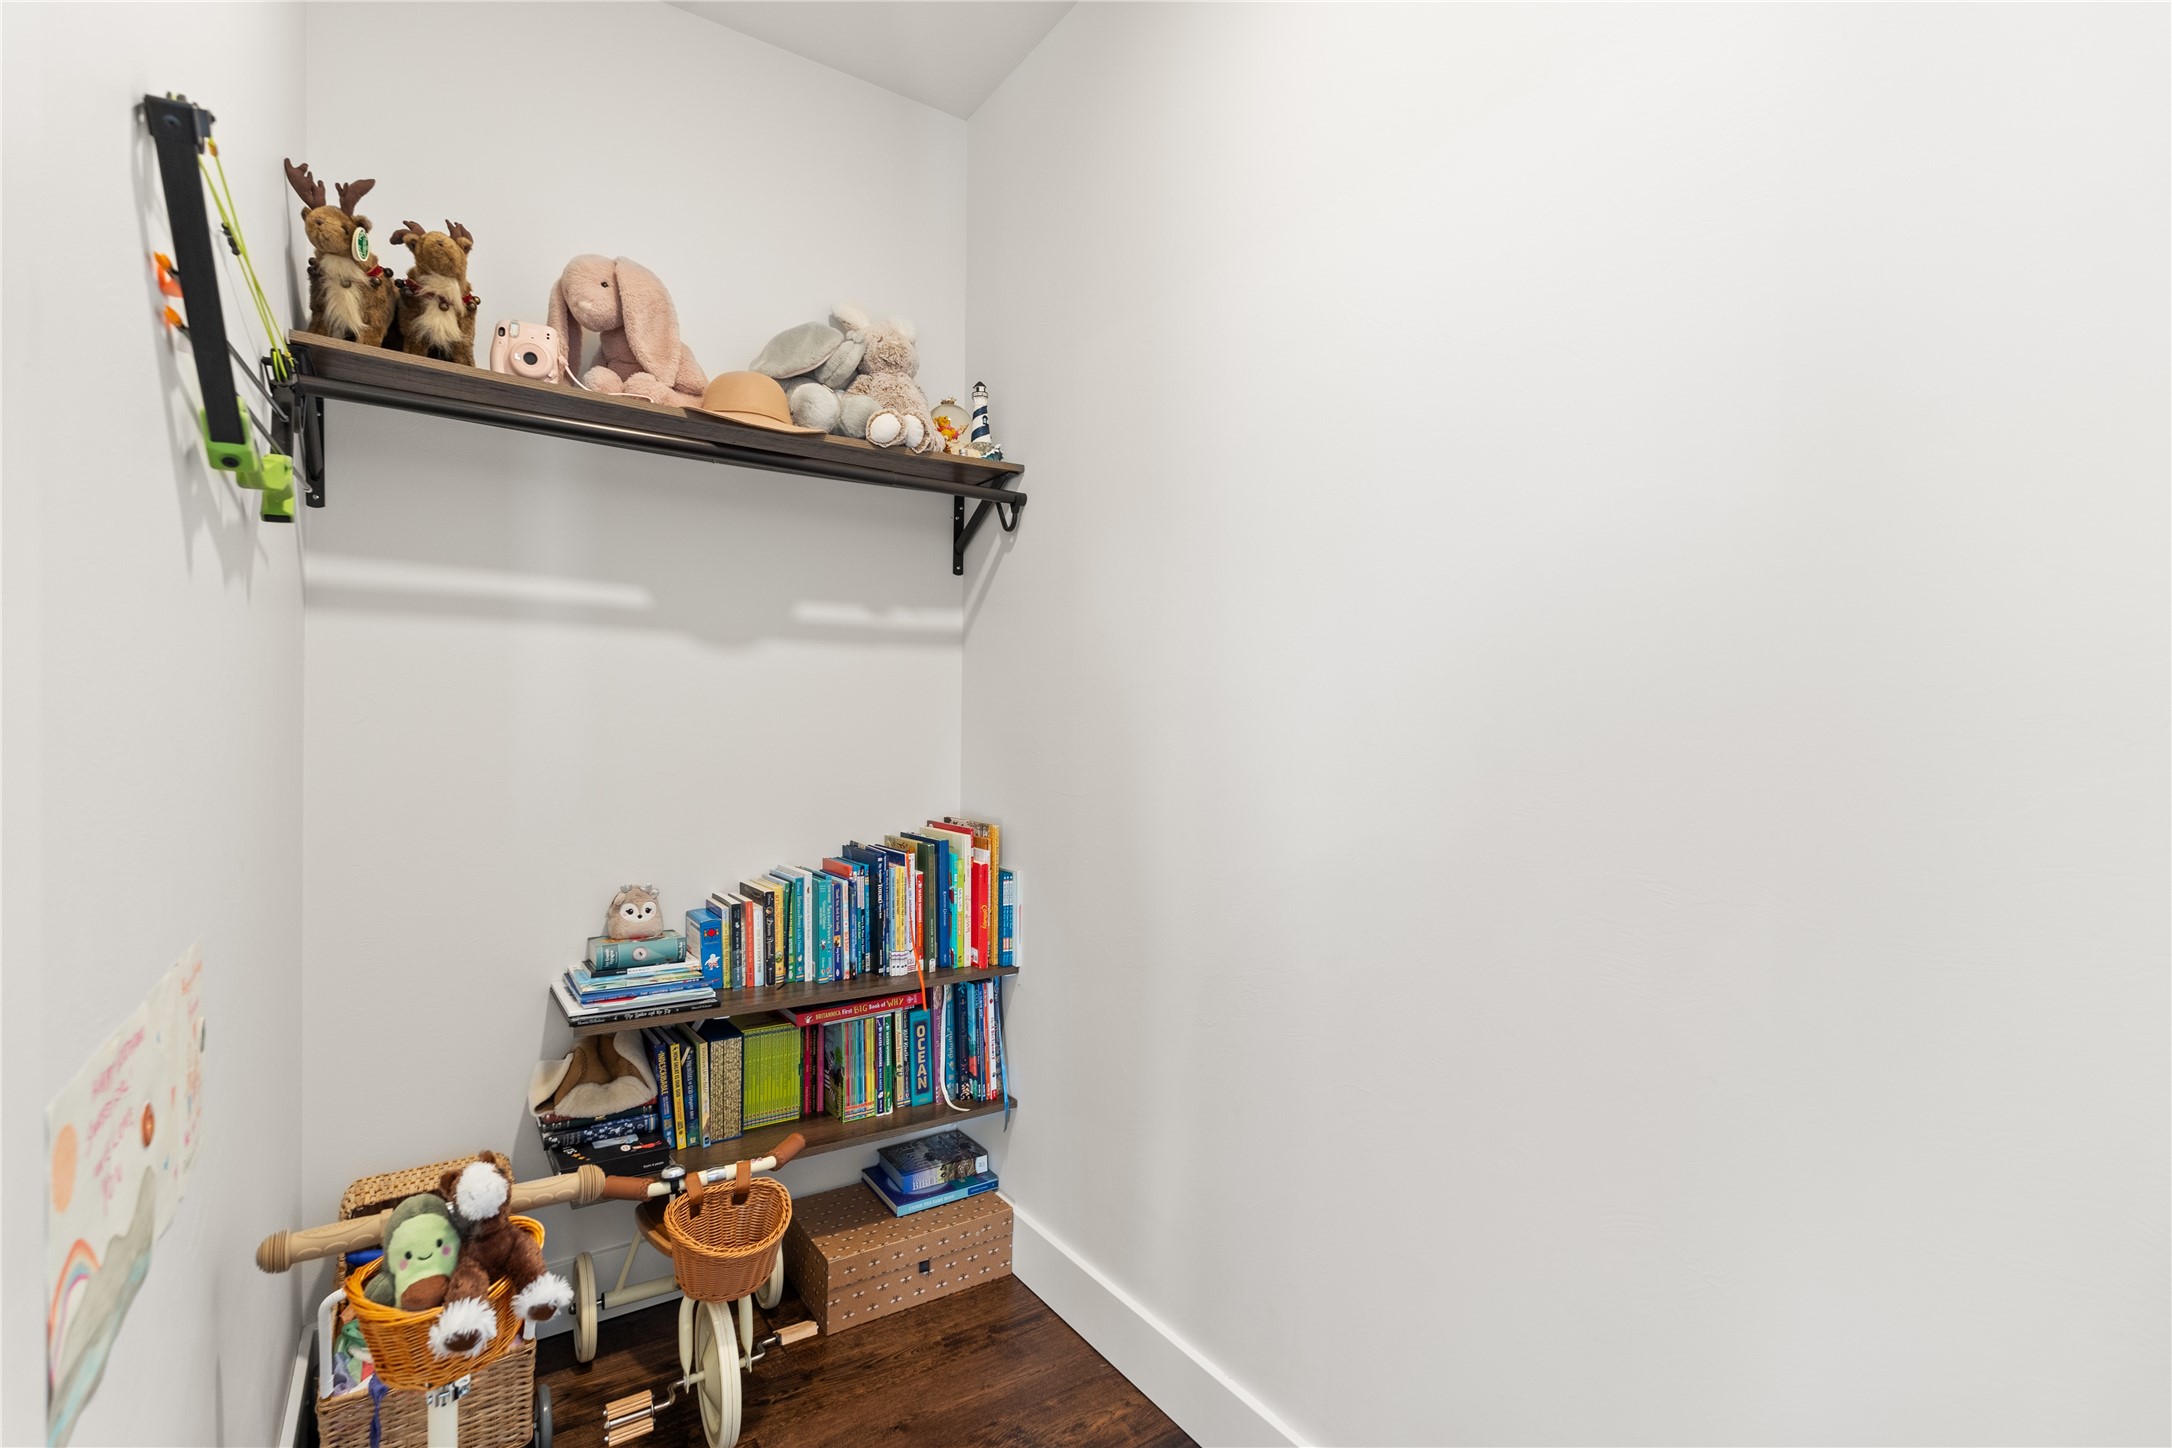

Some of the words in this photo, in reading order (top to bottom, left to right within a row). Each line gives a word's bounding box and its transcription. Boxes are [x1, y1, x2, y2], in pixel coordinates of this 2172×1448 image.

[815, 1010, 841, 1020] BRITANNICA
[853, 1004, 868, 1014] BIG
[886, 998, 904, 1008] WHY
[916, 1024, 927, 1090] OCEAN
[912, 1176, 939, 1191] BIBLE
